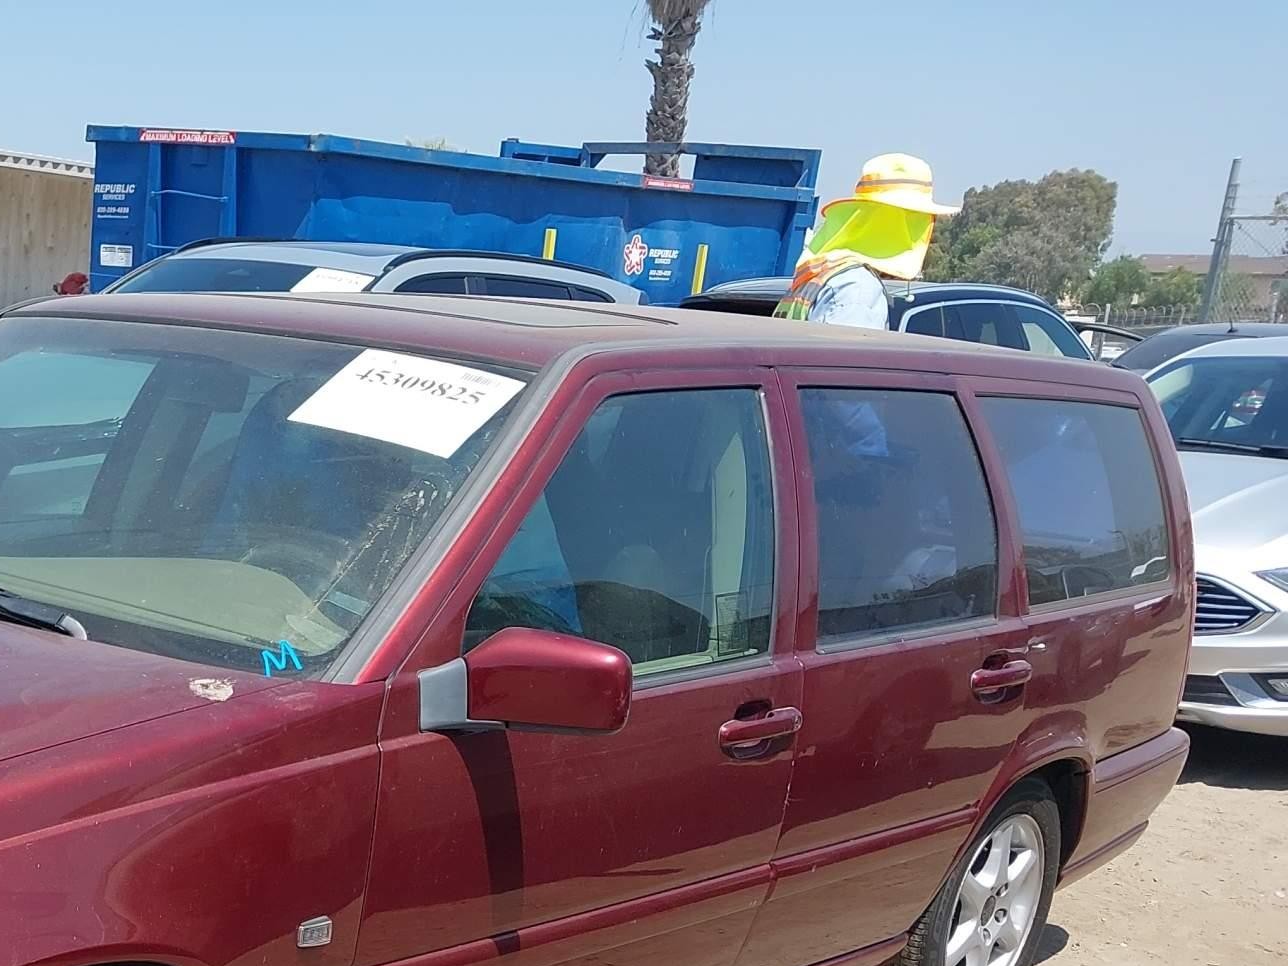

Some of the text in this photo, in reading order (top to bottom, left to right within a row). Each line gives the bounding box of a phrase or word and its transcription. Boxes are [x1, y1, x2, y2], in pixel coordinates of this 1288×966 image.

[94, 183, 136, 194] REPUBLIC
[355, 367, 487, 405] 45309825
[261, 639, 304, 678] M
